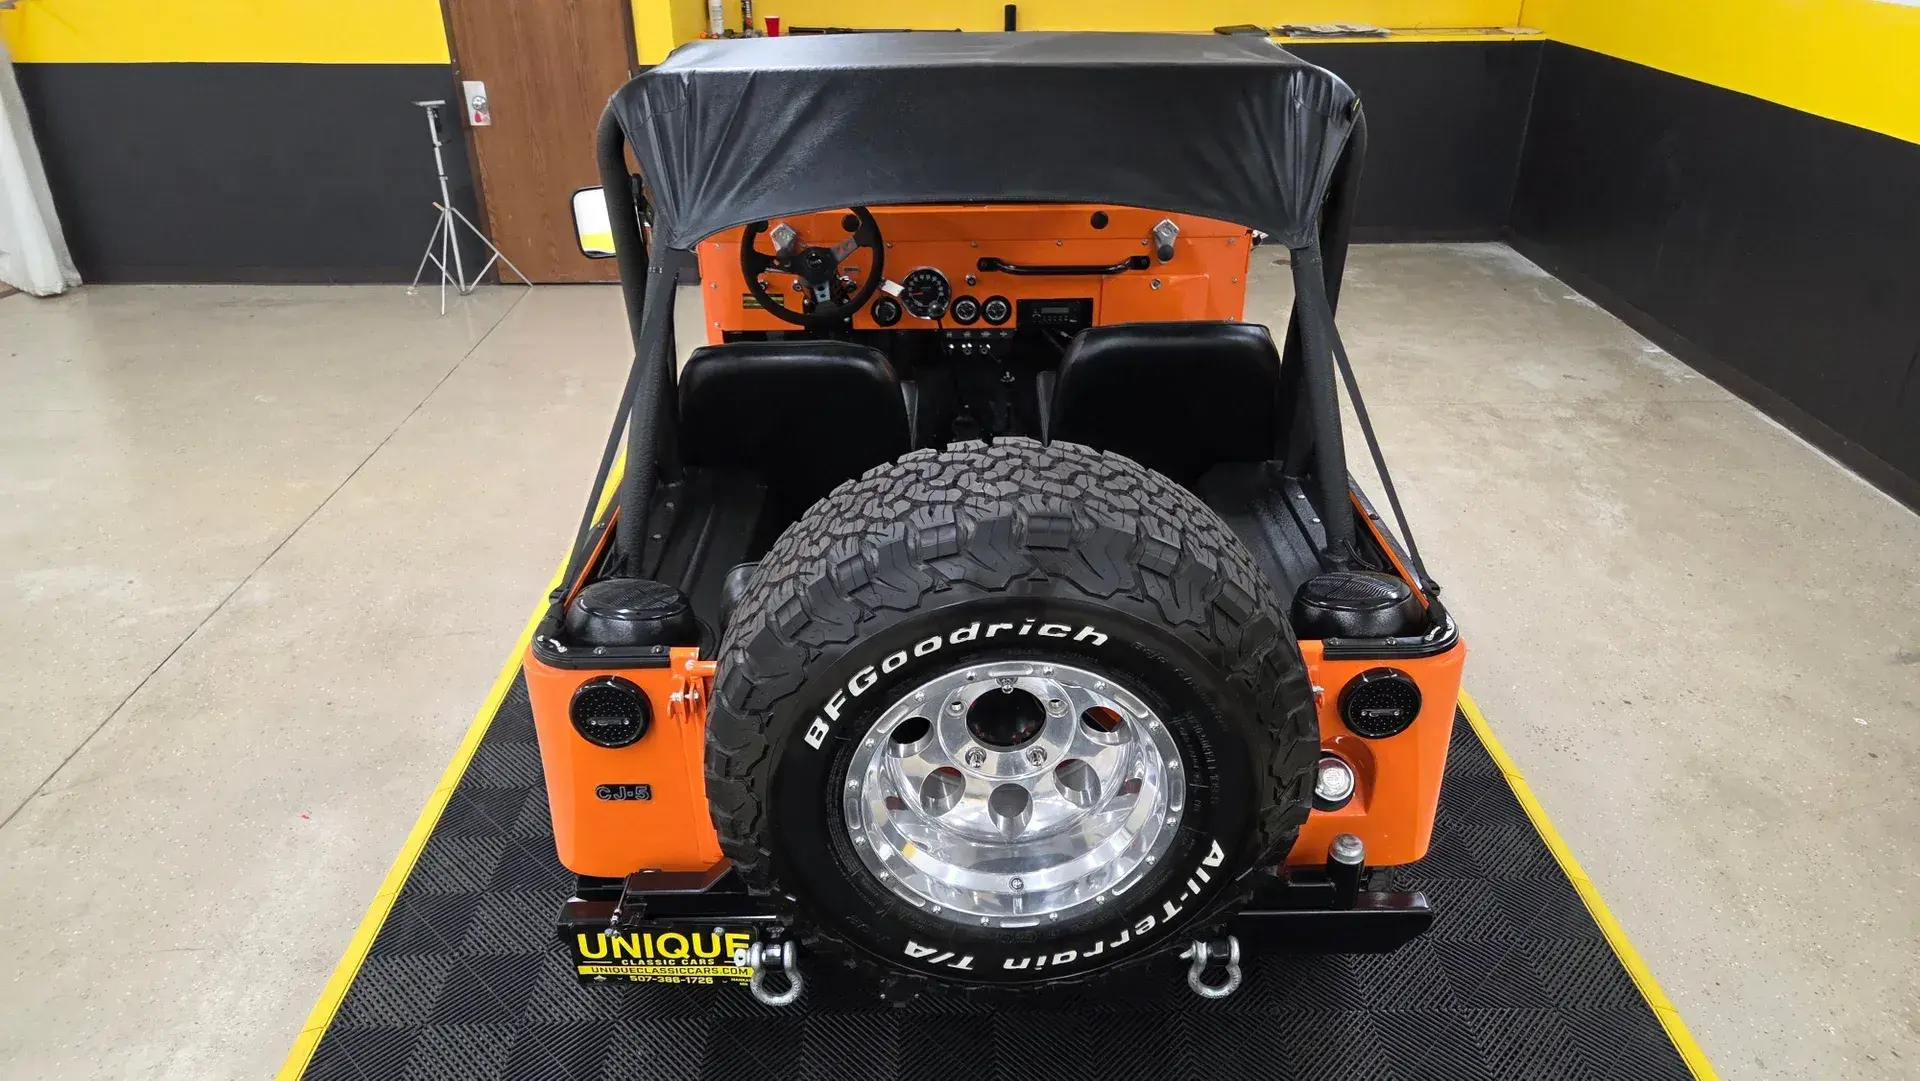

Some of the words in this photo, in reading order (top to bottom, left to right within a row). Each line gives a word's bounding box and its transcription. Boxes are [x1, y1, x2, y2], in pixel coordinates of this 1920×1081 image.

[804, 618, 1109, 750] BFGoodrich
[596, 786, 650, 801] CJ-5
[1003, 839, 1226, 971] All-Terrain
[577, 933, 750, 959] UNIQUE
[904, 940, 974, 971] T/A
[591, 966, 748, 975] UNIQUECLASSICCARS.COM
[629, 975, 714, 984] 507-386-1726
